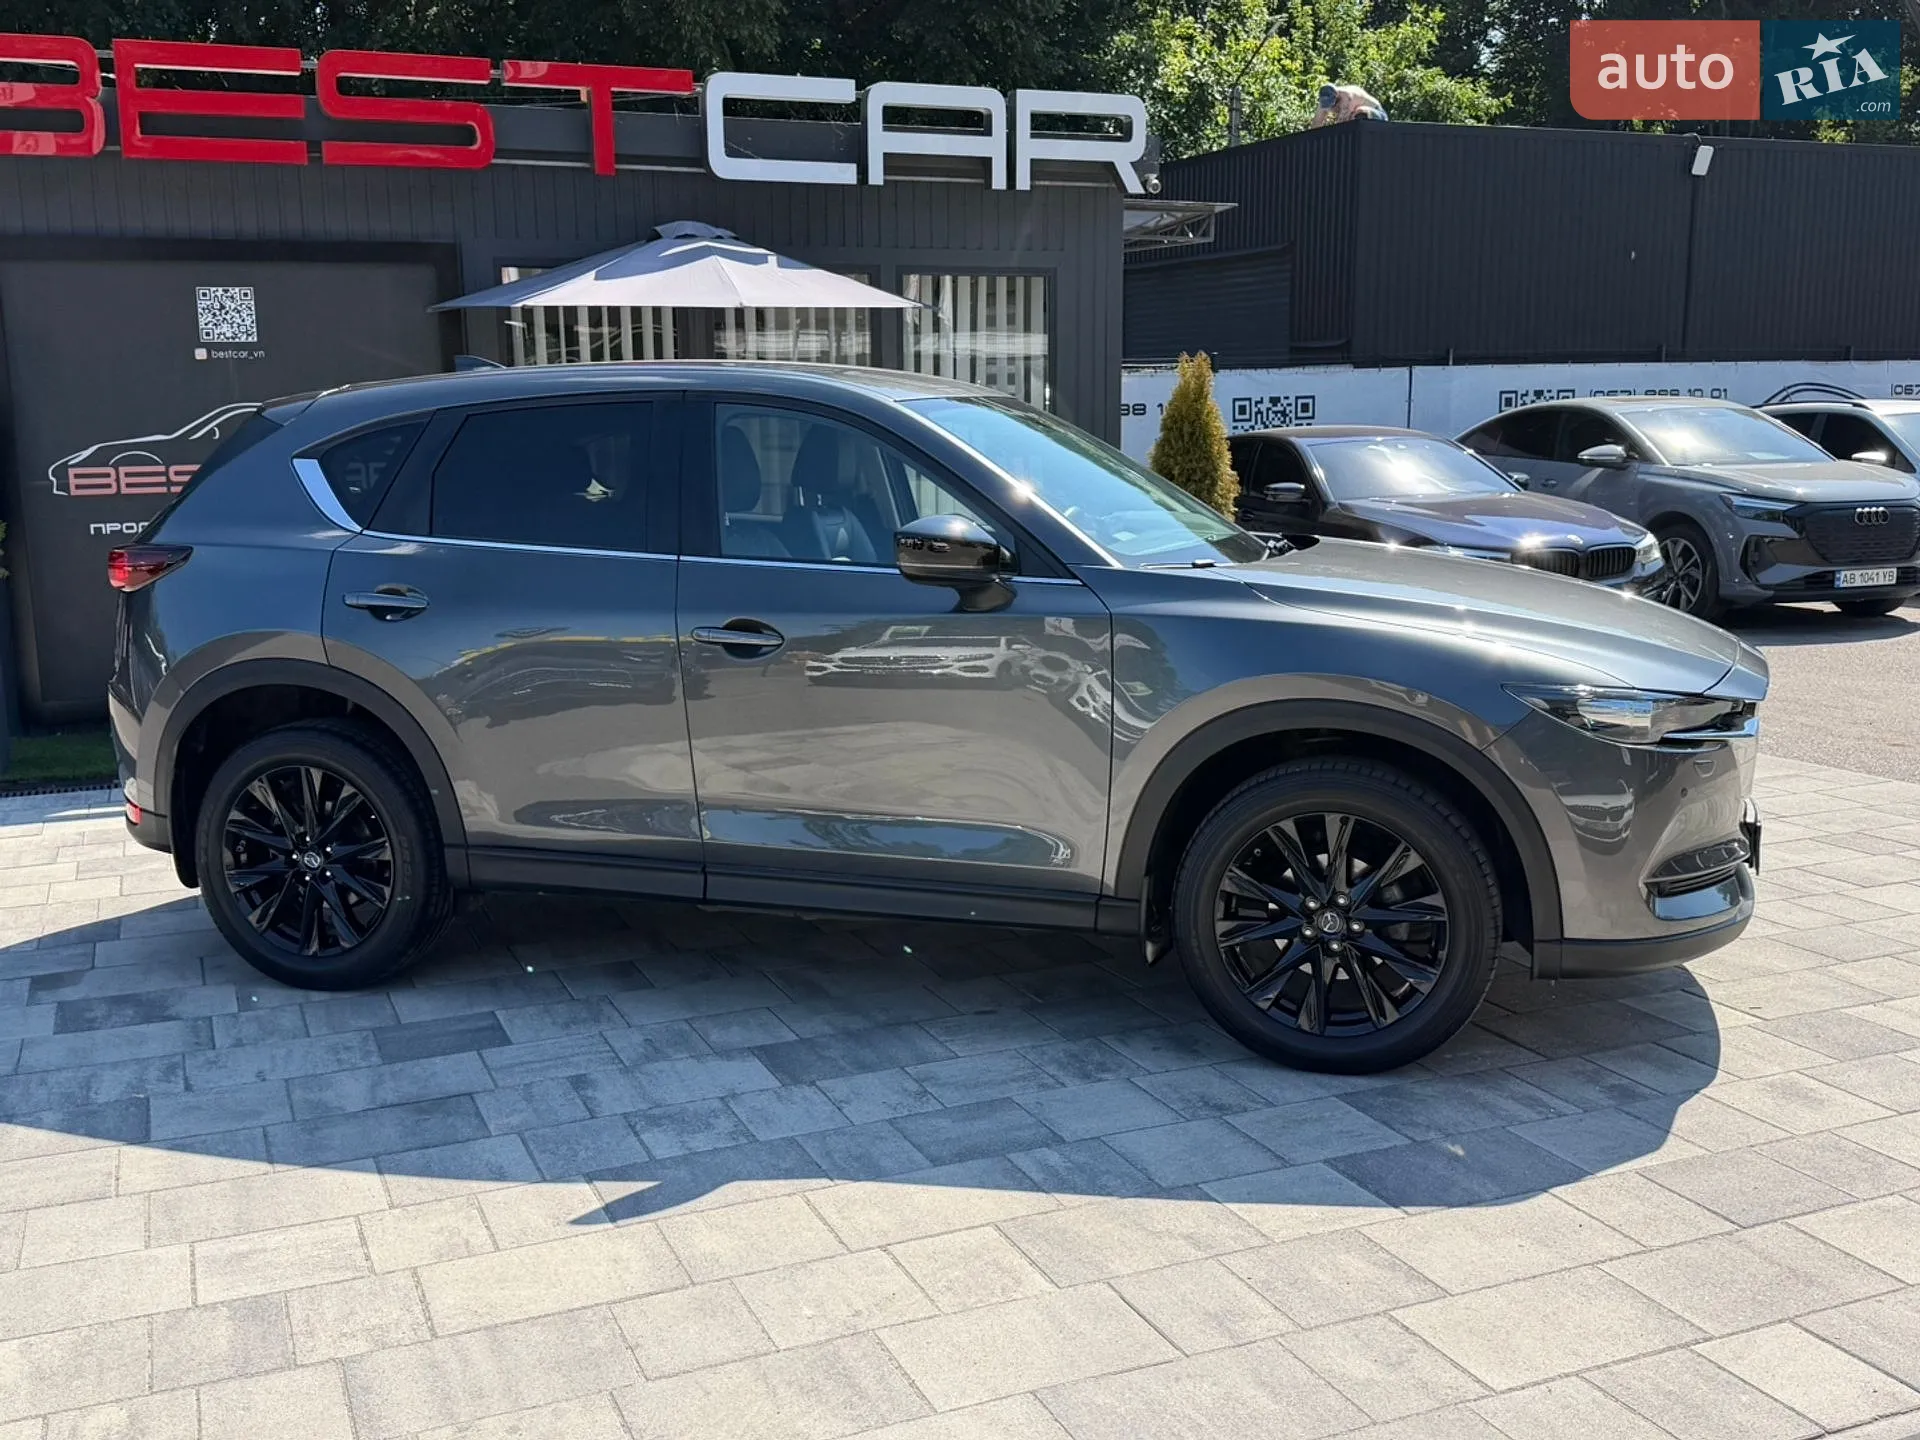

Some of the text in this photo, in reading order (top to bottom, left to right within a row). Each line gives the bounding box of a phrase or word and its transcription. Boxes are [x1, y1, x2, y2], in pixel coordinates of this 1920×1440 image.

[1710, 388, 1728, 399] 01
[1842, 573, 1856, 585] AB
[1859, 572, 1880, 584] 1041
[1882, 570, 1895, 582] YB
